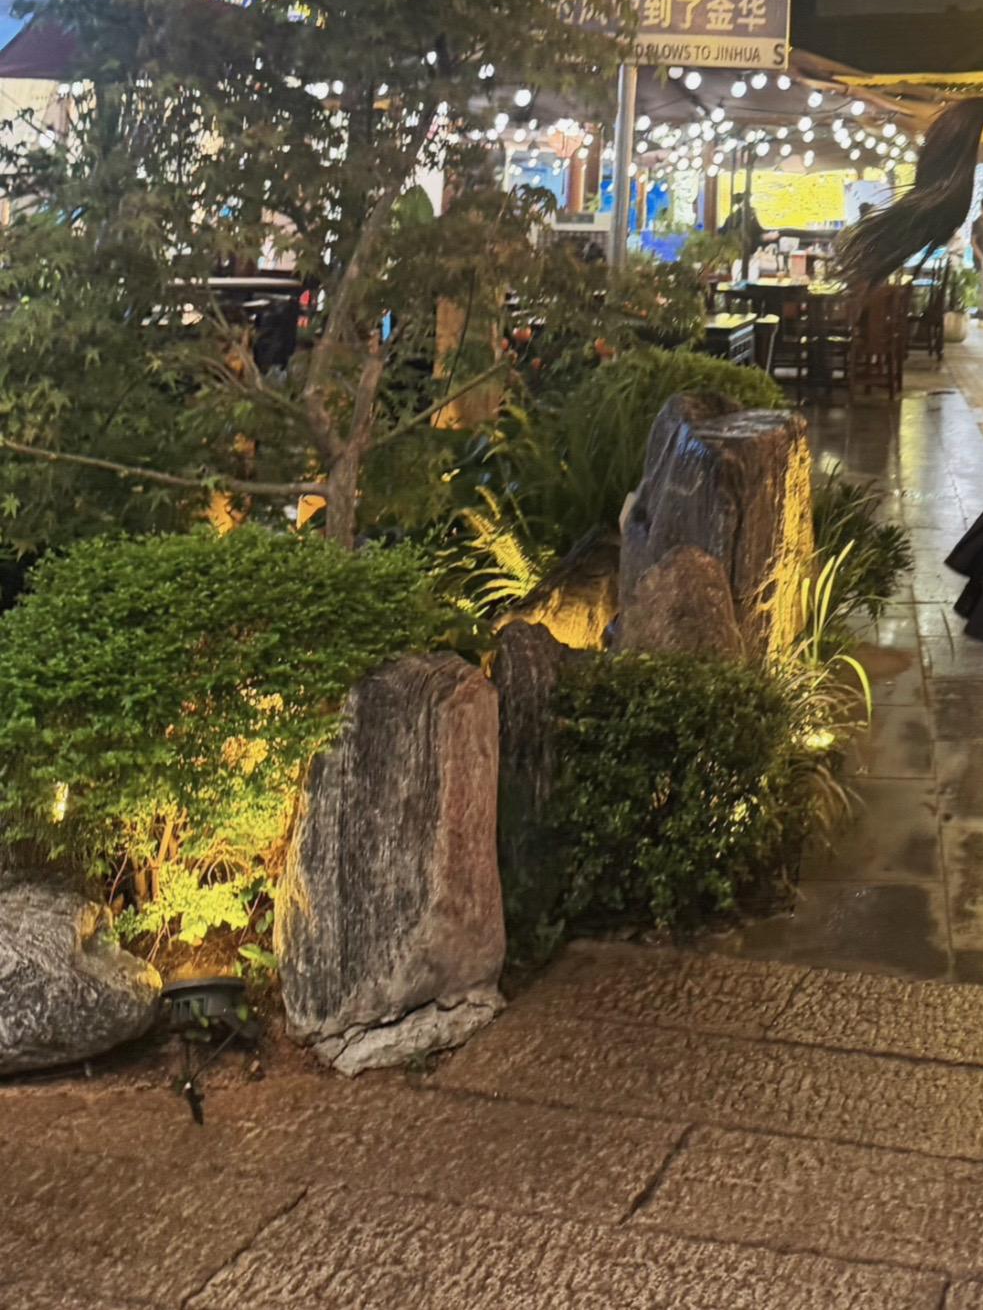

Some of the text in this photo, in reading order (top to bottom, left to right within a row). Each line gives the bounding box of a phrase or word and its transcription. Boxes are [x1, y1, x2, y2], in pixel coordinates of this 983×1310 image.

[694, 45, 711, 61] TO
[713, 45, 761, 63] JINHUA
[773, 42, 786, 66] S
